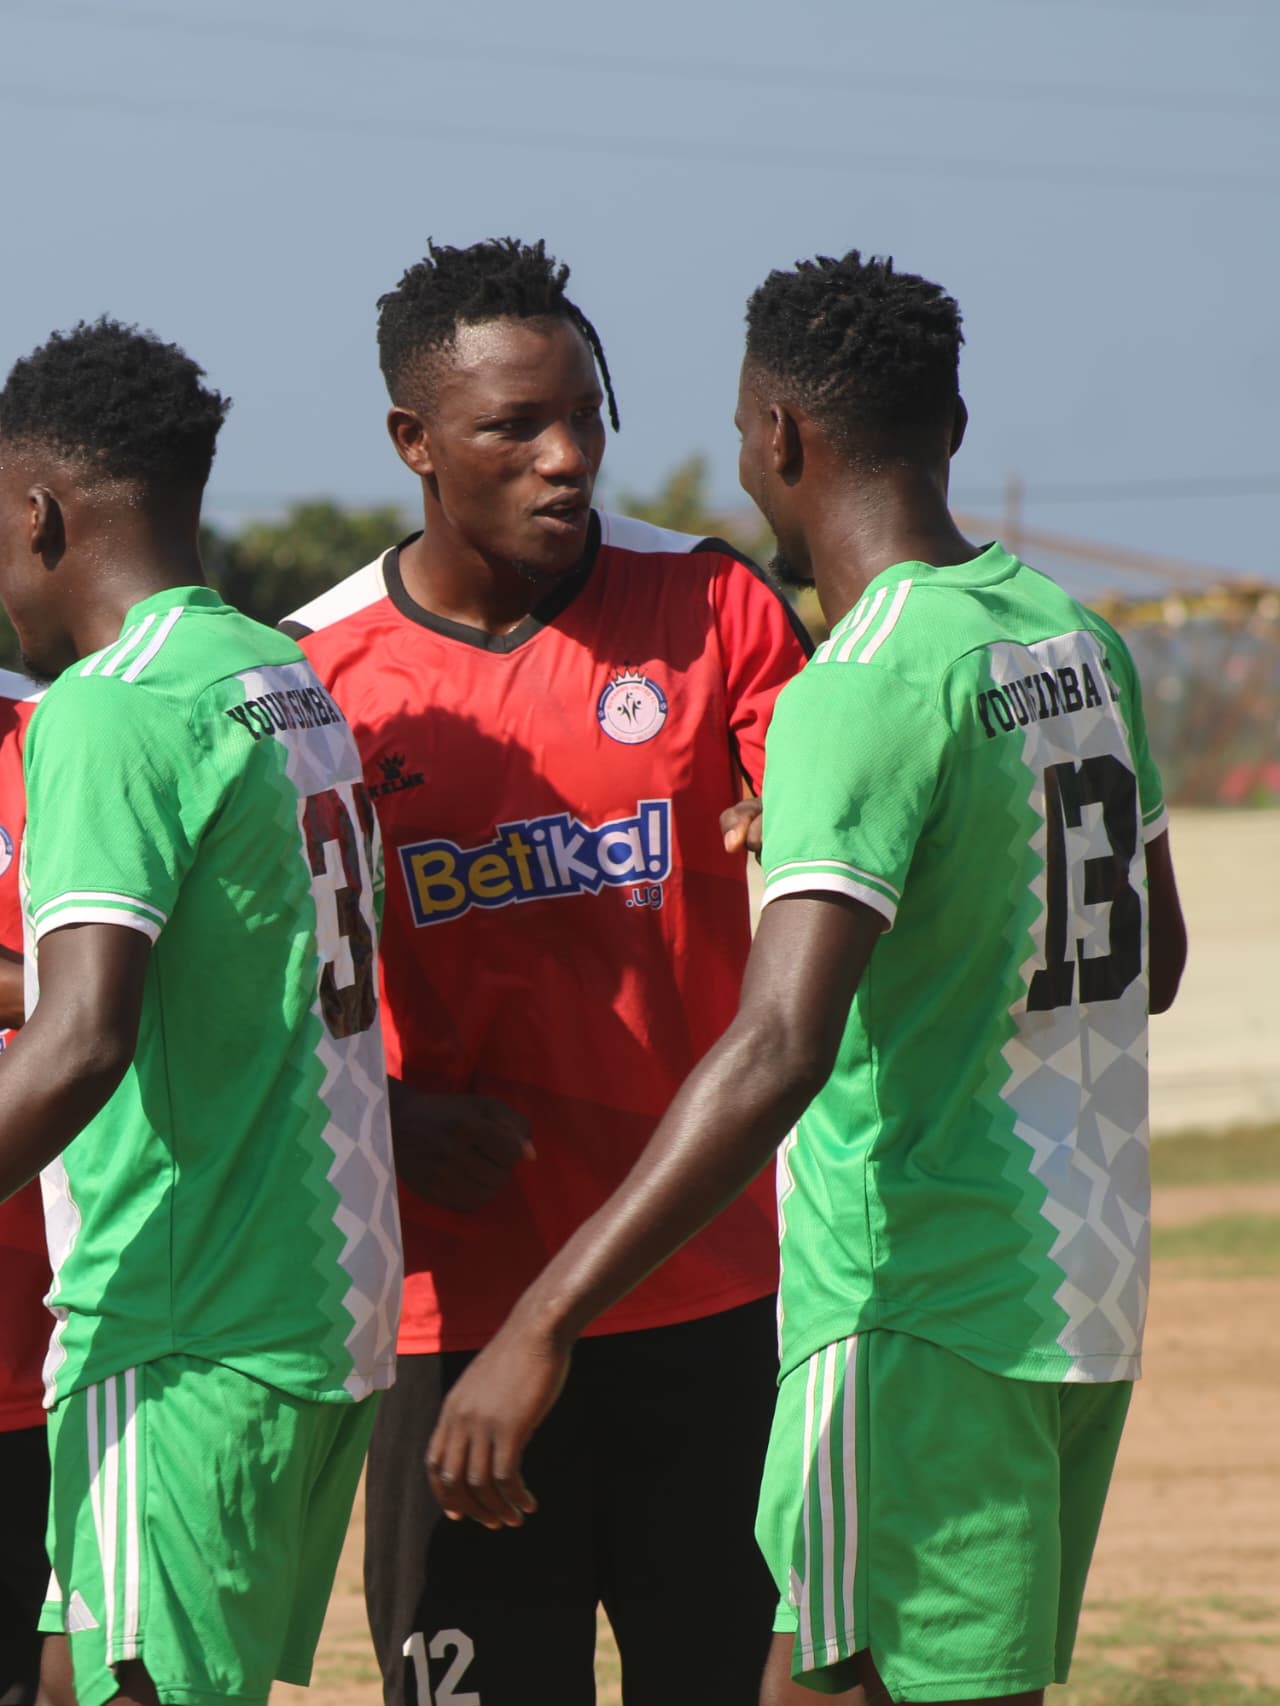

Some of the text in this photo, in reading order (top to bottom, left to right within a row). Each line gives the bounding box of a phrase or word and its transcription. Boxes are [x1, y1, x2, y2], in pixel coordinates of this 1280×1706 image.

[410, 808, 663, 917] Betika!
[1026, 754, 1142, 1013] 13
[402, 1628, 482, 1706] 12
